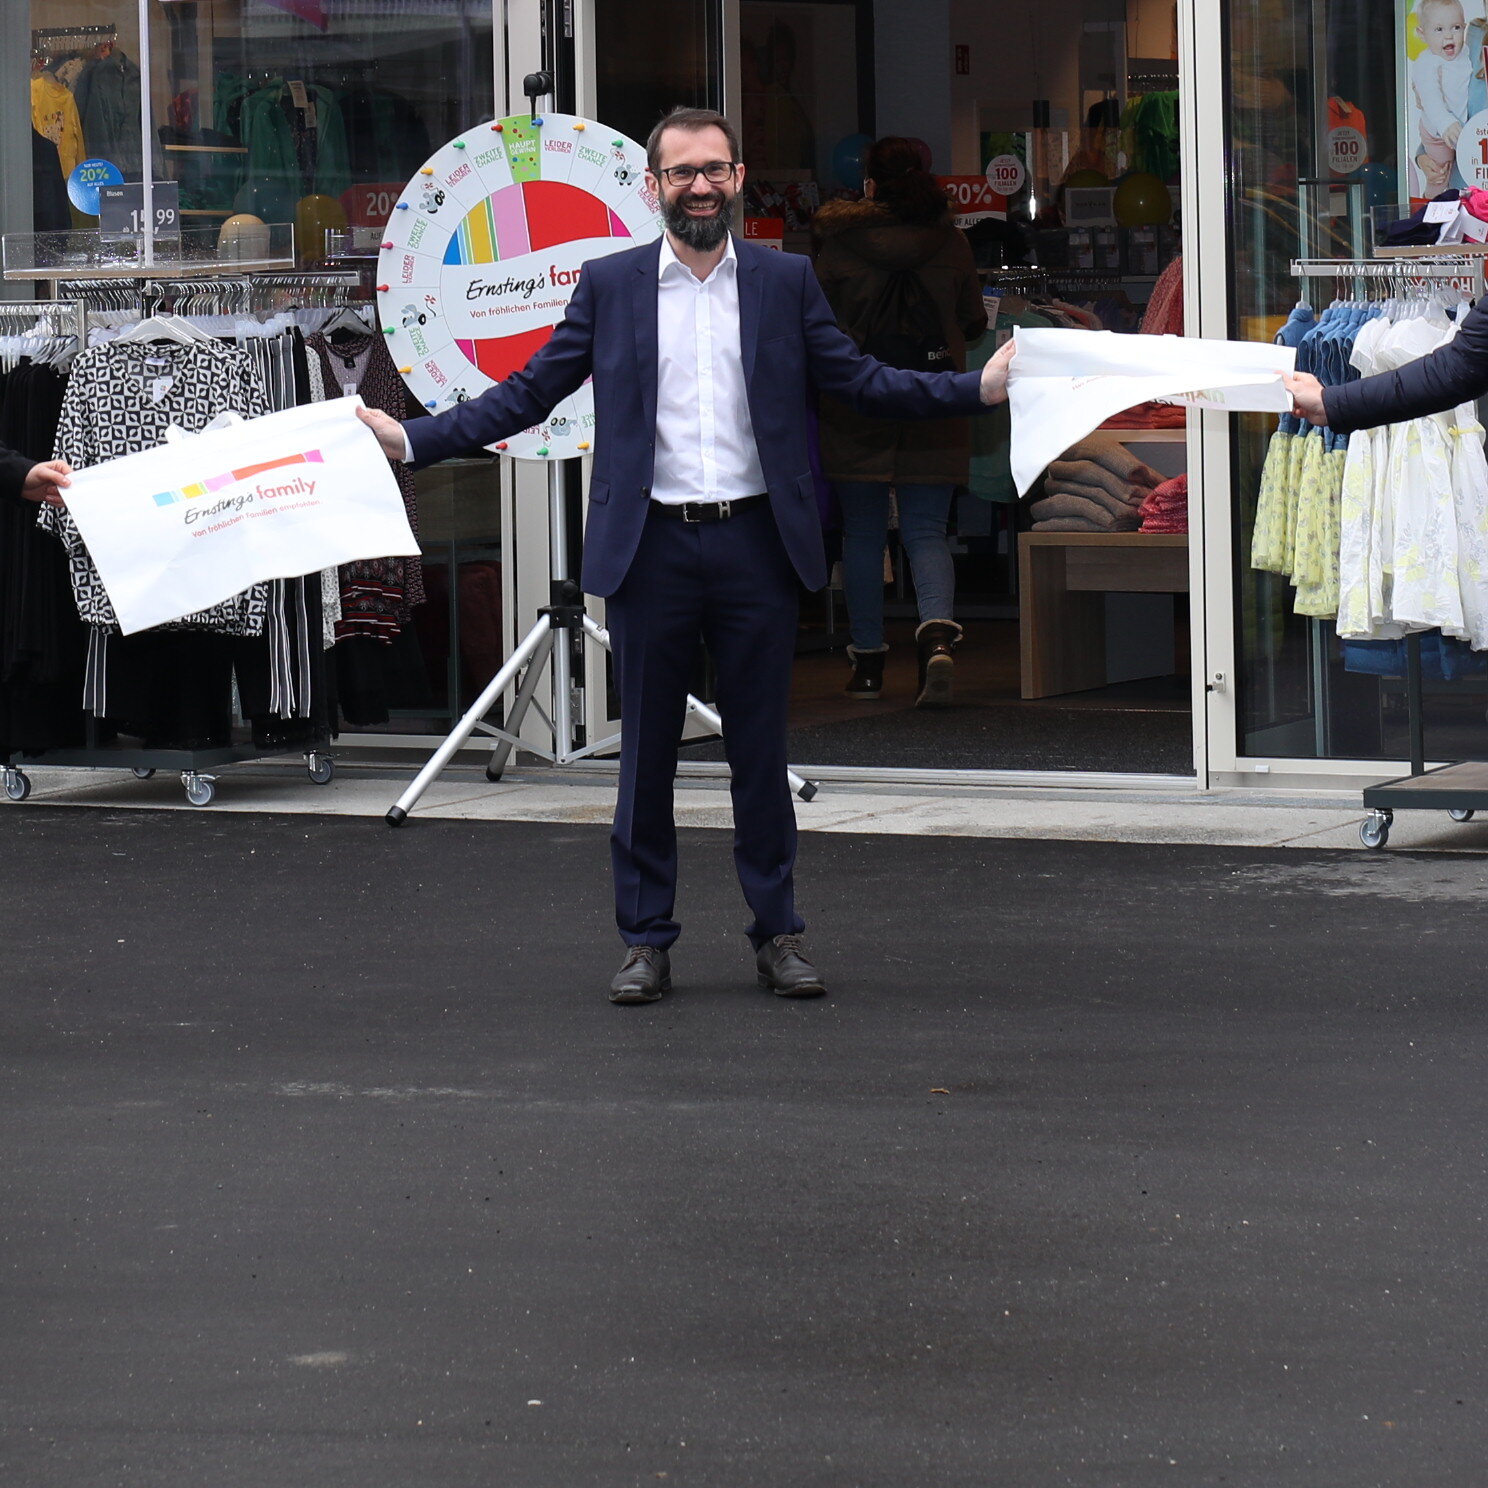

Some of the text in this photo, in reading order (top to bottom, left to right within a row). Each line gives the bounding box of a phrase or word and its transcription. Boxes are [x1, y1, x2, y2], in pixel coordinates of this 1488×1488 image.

[508, 140, 536, 150] HAUPT
[510, 146, 536, 156] GEWINN
[544, 140, 573, 150] LEIDER
[1333, 141, 1359, 155] 100
[473, 146, 502, 162] ZWEITE
[477, 152, 504, 169] CHANCE
[577, 152, 604, 168] CHANCE
[578, 146, 608, 162] ZWEITE
[80, 167, 110, 182] 20%
[445, 163, 469, 184] LEIDER
[995, 167, 1018, 180] 100
[407, 218, 422, 248] ZWEITE
[402, 254, 411, 284] LEIDER
[466, 272, 545, 300] Ernsting's
[470, 298, 569, 319] Von fröhlichen Familien
[409, 329, 425, 357] ZWEITE
[424, 361, 445, 388] LEIDER
[184, 477, 316, 525] Ernsting's family
[192, 529, 207, 538] Von
[208, 514, 244, 534] fröhlichen
[246, 507, 278, 519] Familien
